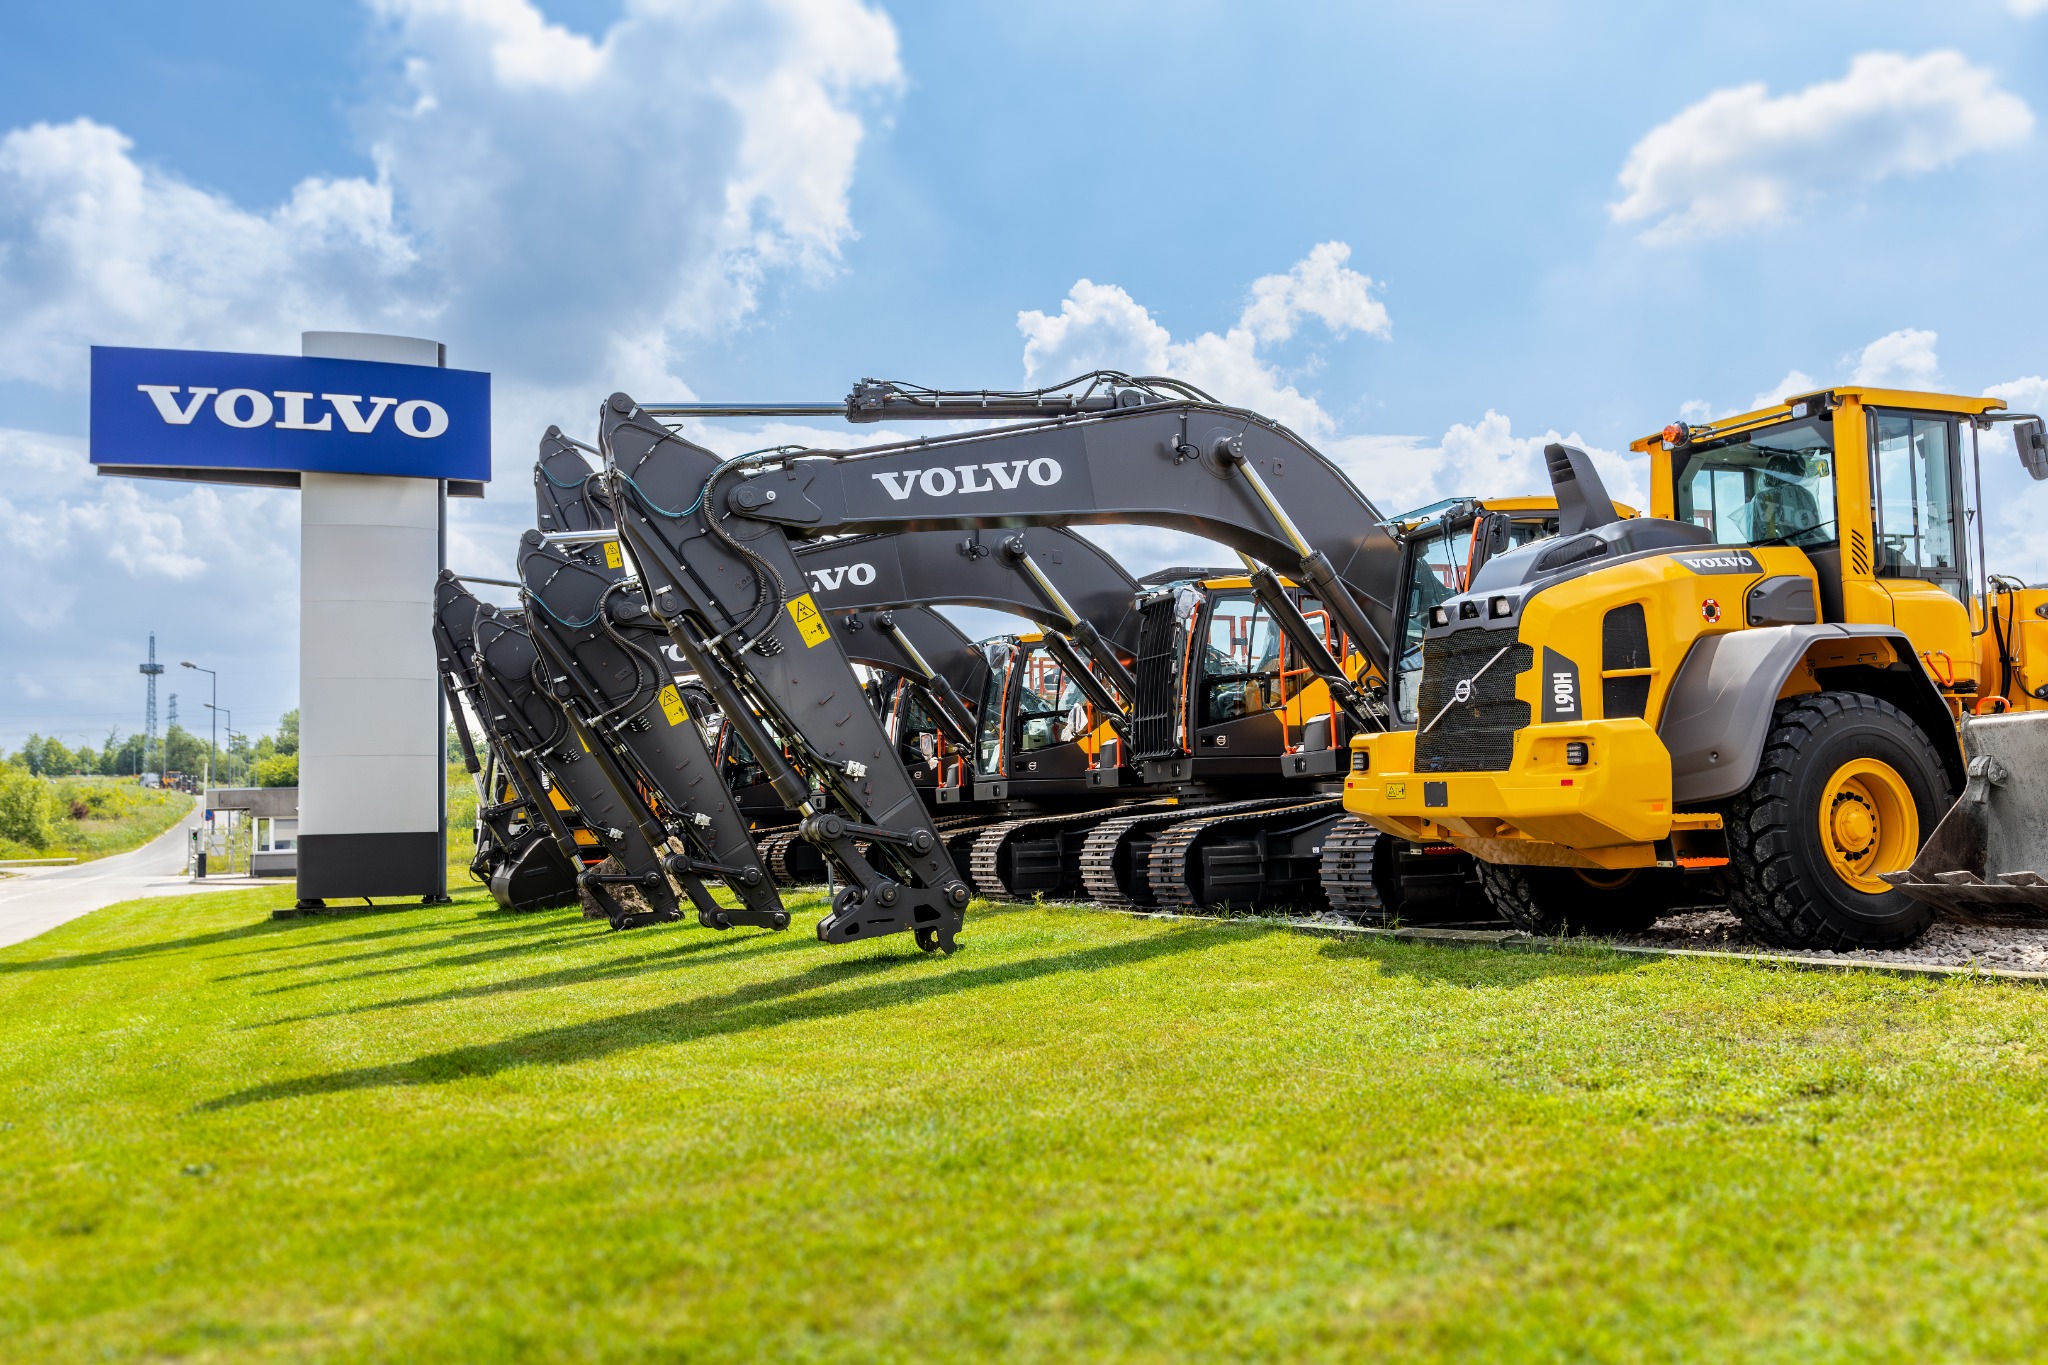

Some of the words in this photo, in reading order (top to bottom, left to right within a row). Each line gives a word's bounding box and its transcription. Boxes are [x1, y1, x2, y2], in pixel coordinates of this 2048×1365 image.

[137, 384, 449, 438] VOLVO
[871, 457, 1062, 501] VOLVO
[805, 562, 877, 593] VO
[1683, 556, 1753, 569] VOLVO
[1553, 672, 1575, 713] L90H
